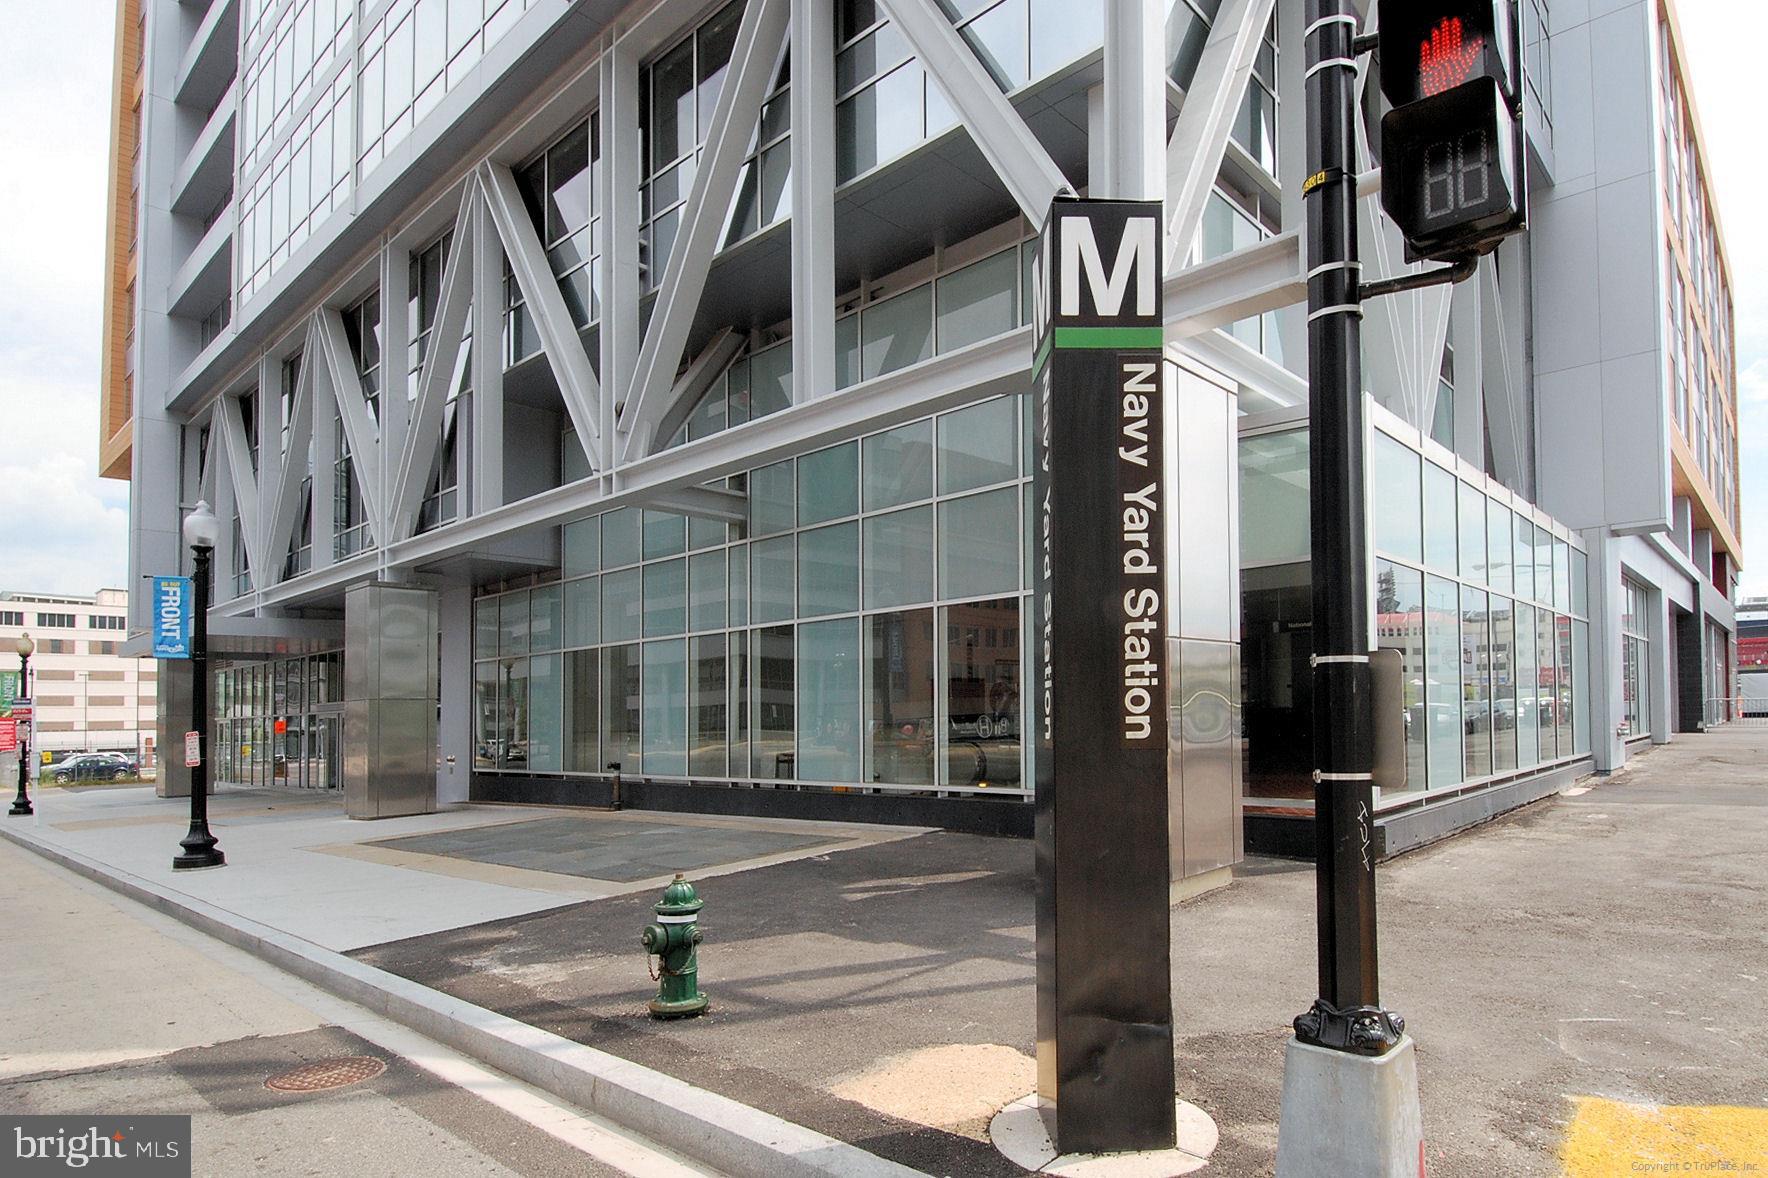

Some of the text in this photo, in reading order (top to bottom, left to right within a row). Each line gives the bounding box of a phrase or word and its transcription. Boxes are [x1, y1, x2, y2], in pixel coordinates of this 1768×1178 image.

[1032, 222, 1051, 354] M
[1061, 217, 1156, 316] M
[1042, 485, 1052, 580] Yard
[1119, 363, 1159, 740] Navy Yard Station
[161, 586, 181, 640] FRONT
[1043, 591, 1053, 740] Station
